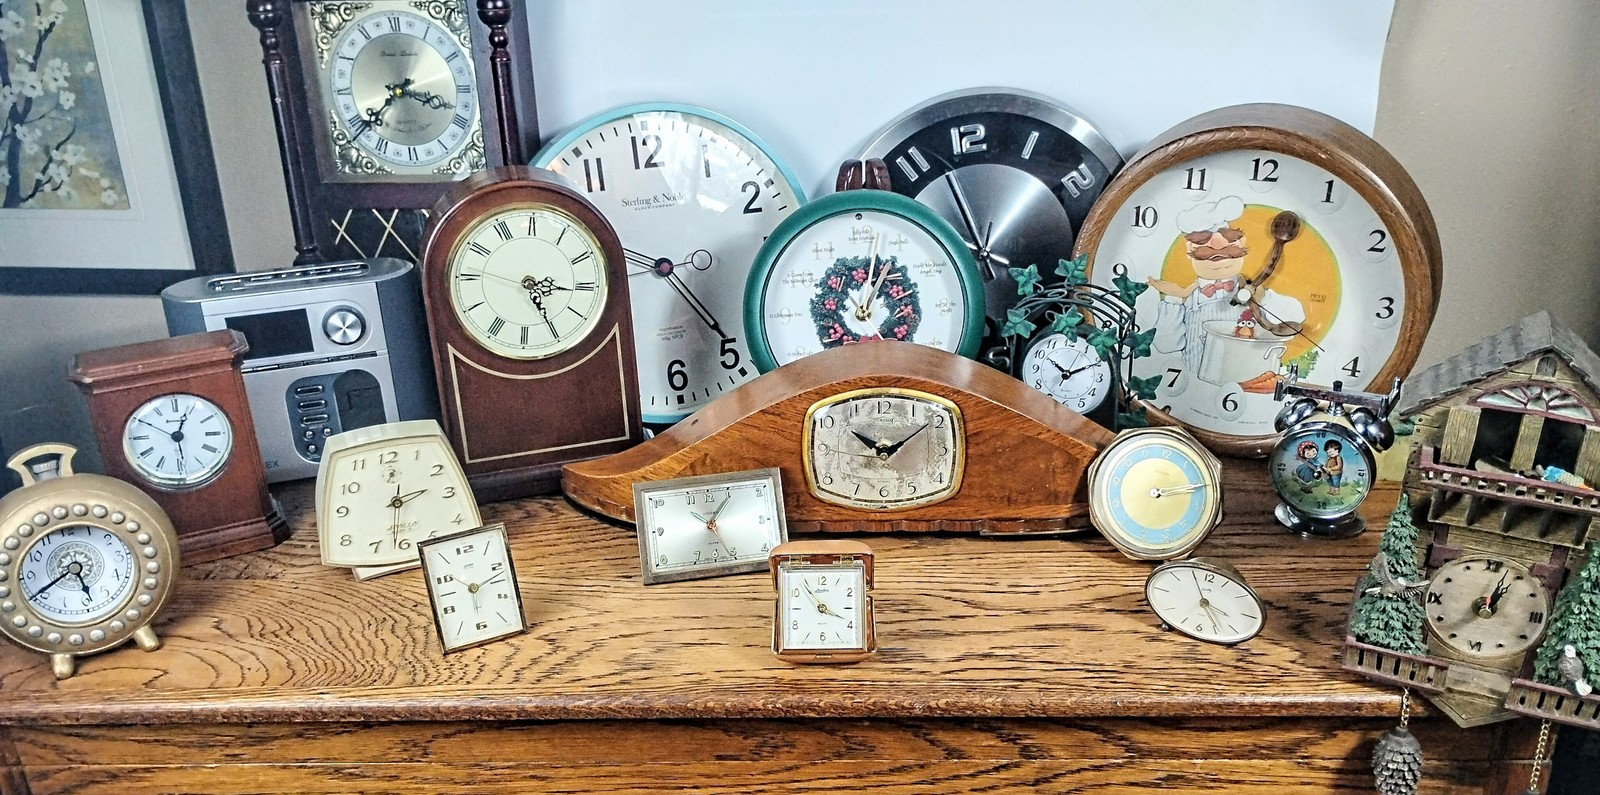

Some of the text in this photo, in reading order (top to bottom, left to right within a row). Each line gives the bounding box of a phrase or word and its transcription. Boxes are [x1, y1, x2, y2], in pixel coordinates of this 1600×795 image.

[950, 123, 988, 155] 12
[1020, 131, 1040, 160] 1
[630, 134, 665, 170] 12
[702, 144, 711, 178] 1
[896, 146, 931, 183] 11
[583, 157, 606, 193] 11
[1249, 158, 1280, 183] 12
[1060, 163, 1096, 199] 2
[1183, 167, 1208, 192] 11
[741, 180, 763, 215] 2
[1321, 180, 1335, 204] 1
[621, 192, 687, 208] Sterling & Noble
[1131, 205, 1159, 229] 10
[1367, 229, 1387, 253] 2
[1375, 297, 1395, 320] 3
[1047, 339, 1057, 349] 11
[1085, 345, 1090, 354] 1
[719, 337, 740, 370] 5
[1034, 350, 1045, 359] 10
[1032, 364, 1040, 375] 9
[1341, 356, 1361, 378] 4
[667, 359, 689, 391] 6
[1096, 373, 1103, 383] 3
[1166, 368, 1182, 388] 7
[1034, 378, 1042, 390] 8
[1088, 387, 1096, 397] 4
[877, 401, 892, 415] 12
[1077, 398, 1086, 408] 5
[1222, 392, 1239, 412] 6
[911, 404, 915, 418] 1
[820, 415, 835, 429] 10
[934, 415, 945, 429] 2
[414, 449, 420, 461] 1
[818, 443, 830, 457] 9
[939, 443, 948, 456] 3
[352, 457, 366, 472] 11
[378, 451, 399, 465] 12
[430, 464, 444, 477] 2
[823, 472, 833, 485] 8
[933, 472, 944, 485] 4
[342, 481, 361, 496] 10
[442, 486, 455, 499] 3
[756, 488, 763, 497] 2
[852, 483, 861, 496] 7
[879, 485, 889, 498] 6
[908, 482, 917, 495] 5
[653, 499, 665, 508] 10
[686, 495, 696, 505] 11
[703, 493, 714, 503] 12
[336, 505, 349, 518] 9
[451, 512, 464, 525] 4
[759, 515, 766, 524] 3
[657, 527, 664, 536] 9
[41, 535, 51, 546] 11
[104, 533, 112, 546] 2
[340, 534, 352, 547] 8
[398, 538, 411, 550] 6
[368, 540, 383, 554] 7
[711, 549, 719, 558] 6
[730, 547, 737, 556] 5
[761, 543, 769, 552] 4
[29, 550, 43, 563] 10
[115, 550, 124, 562] 3
[660, 555, 668, 564] 8
[694, 551, 701, 561] 7
[27, 570, 36, 582] 9
[111, 568, 123, 581] 4
[818, 576, 827, 586] 12
[1204, 573, 1215, 583] 12
[100, 585, 110, 598] 5
[791, 588, 800, 598] 10
[847, 588, 853, 597] 2
[1428, 592, 1443, 605] IX
[1529, 611, 1543, 624] III
[792, 620, 799, 630] 8
[847, 621, 853, 629] 4
[1195, 623, 1203, 632] 6
[820, 632, 827, 641] 6
[1467, 640, 1482, 652] VI
